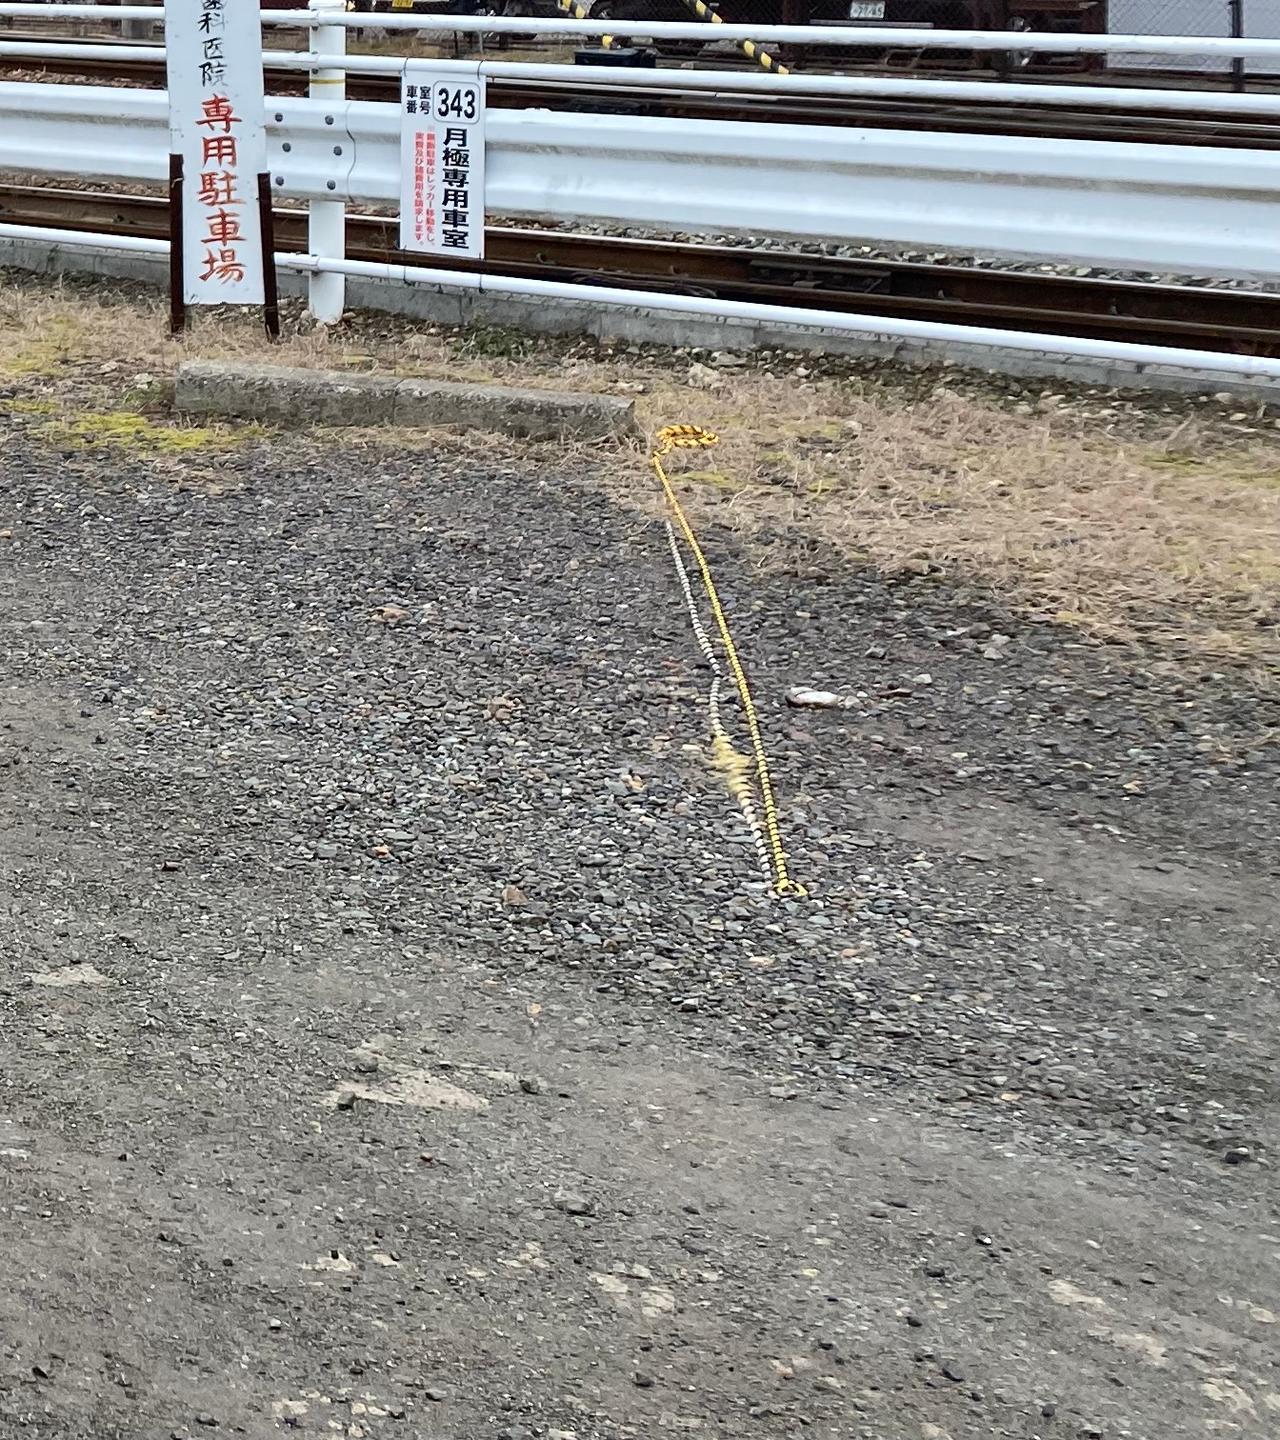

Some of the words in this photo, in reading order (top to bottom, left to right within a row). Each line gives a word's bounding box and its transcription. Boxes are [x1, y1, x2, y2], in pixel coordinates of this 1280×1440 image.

[437, 87, 476, 119] 343
[195, 93, 247, 285] 専用駐車場
[441, 127, 470, 249] 月極専用車室
